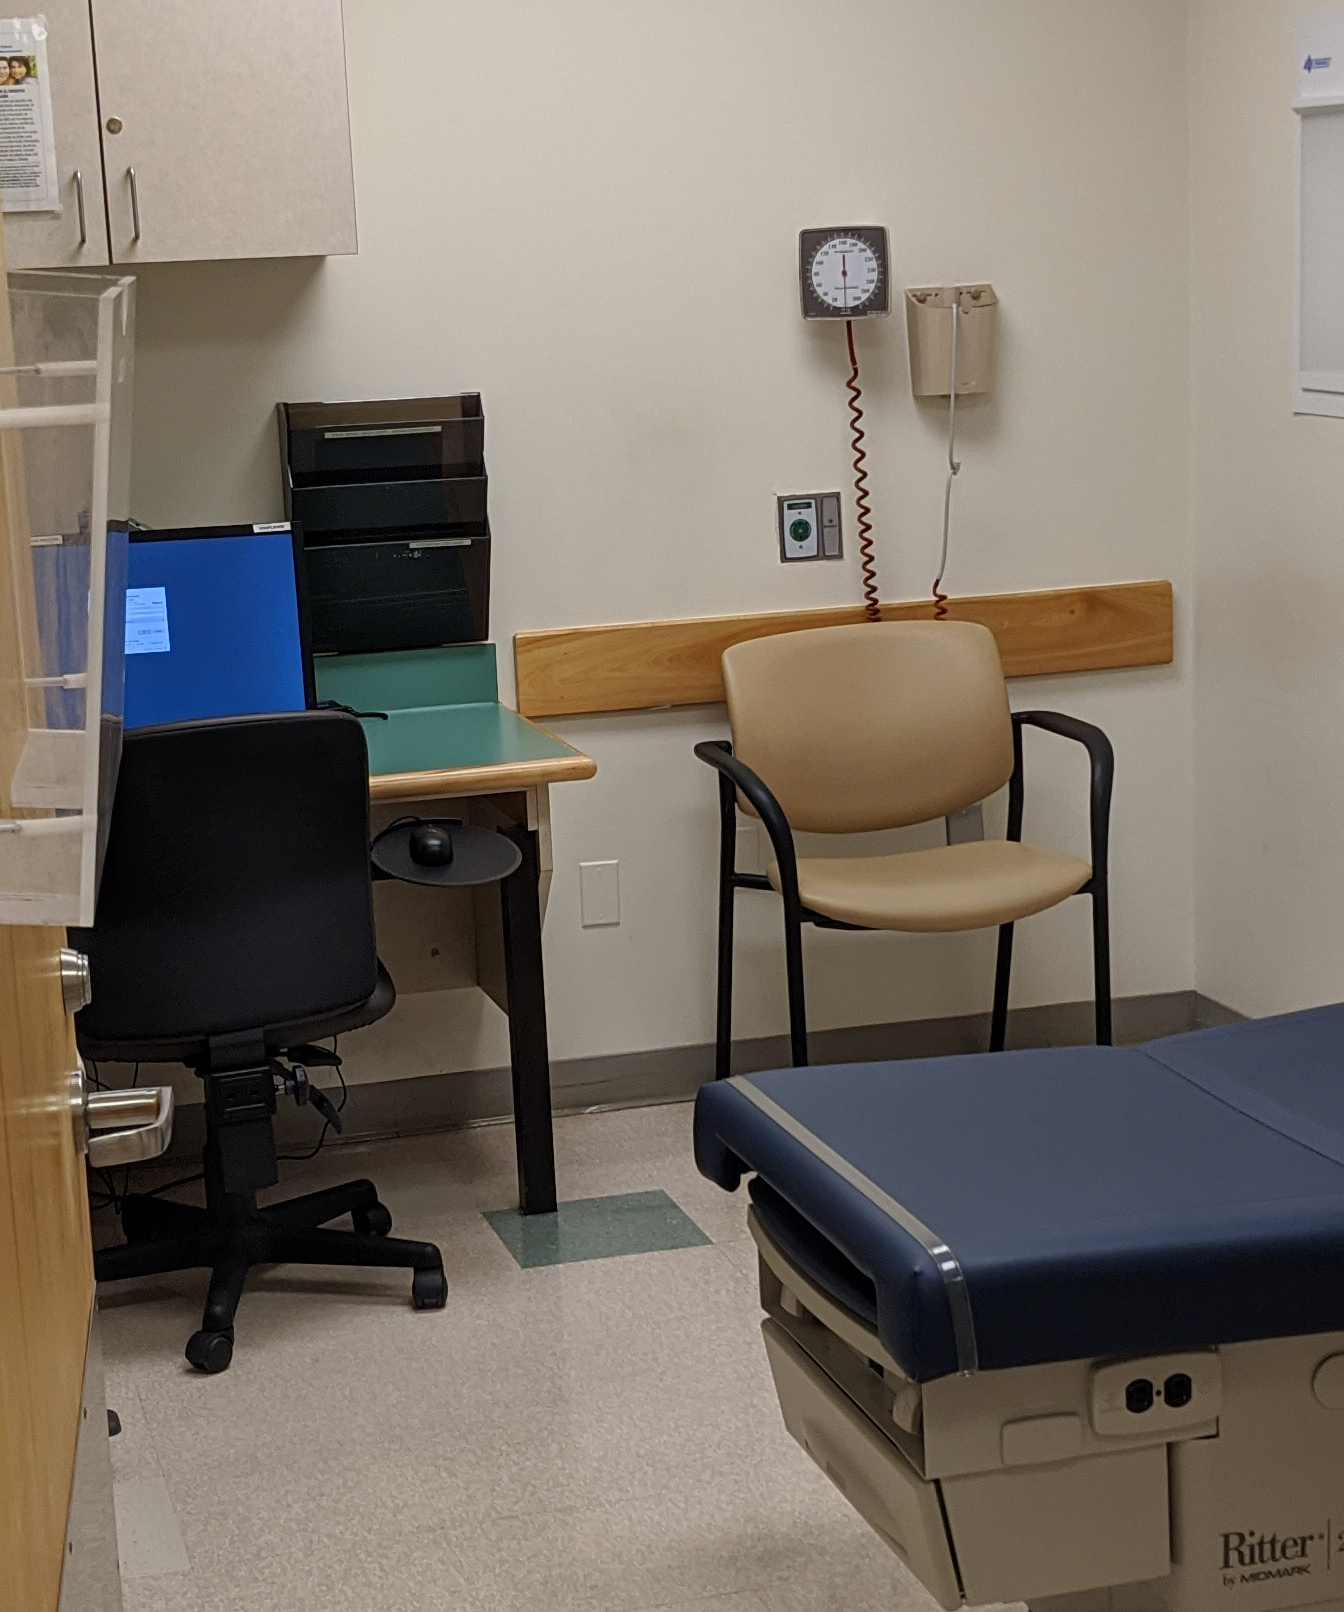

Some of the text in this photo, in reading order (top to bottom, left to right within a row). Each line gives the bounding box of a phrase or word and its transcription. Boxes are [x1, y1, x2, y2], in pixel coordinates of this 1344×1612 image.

[1219, 1530, 1315, 1571] Ritter
[1223, 1564, 1312, 1590] by MIDMARK
